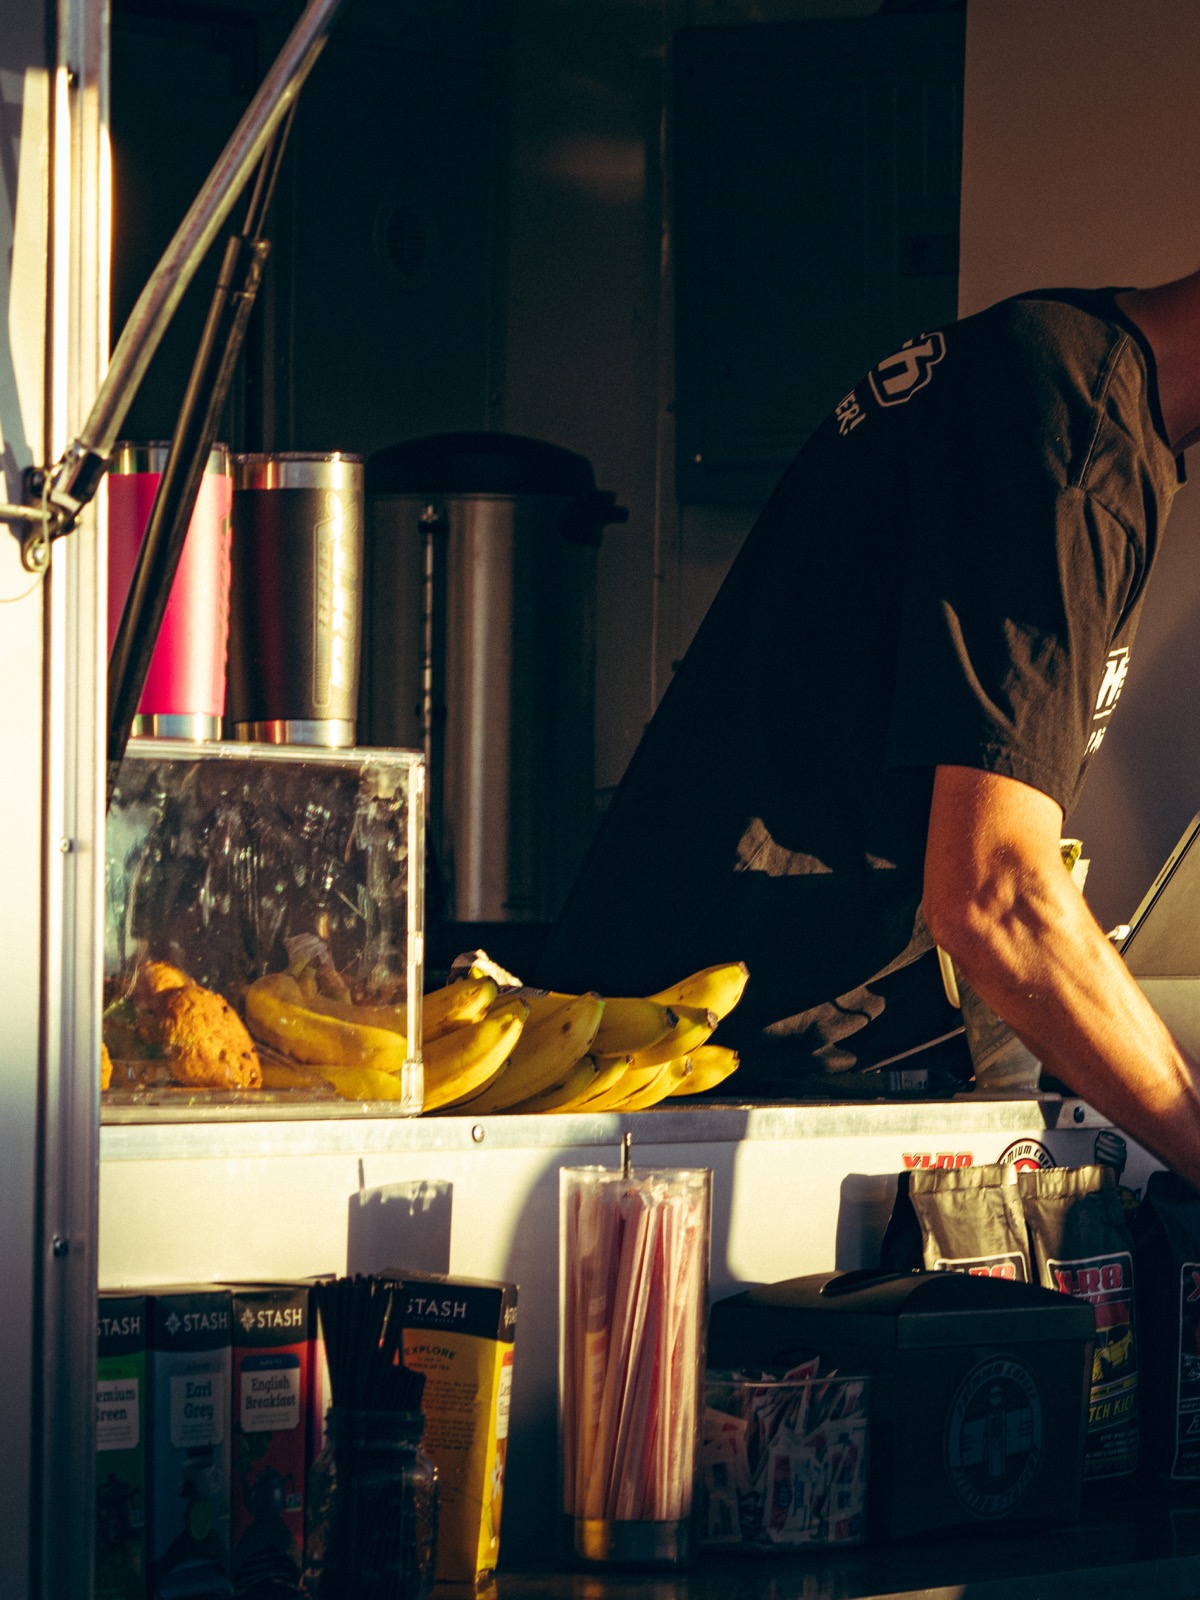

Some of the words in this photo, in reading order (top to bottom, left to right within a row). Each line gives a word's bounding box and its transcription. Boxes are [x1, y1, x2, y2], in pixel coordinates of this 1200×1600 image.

[183, 1311, 229, 1332] STASH
[256, 1308, 303, 1329] STASH
[96, 1386, 136, 1403] emium
[186, 1381, 212, 1399] Earl
[252, 1376, 290, 1395] English
[184, 1402, 213, 1421] Grey
[245, 1394, 297, 1411] Breakfast
